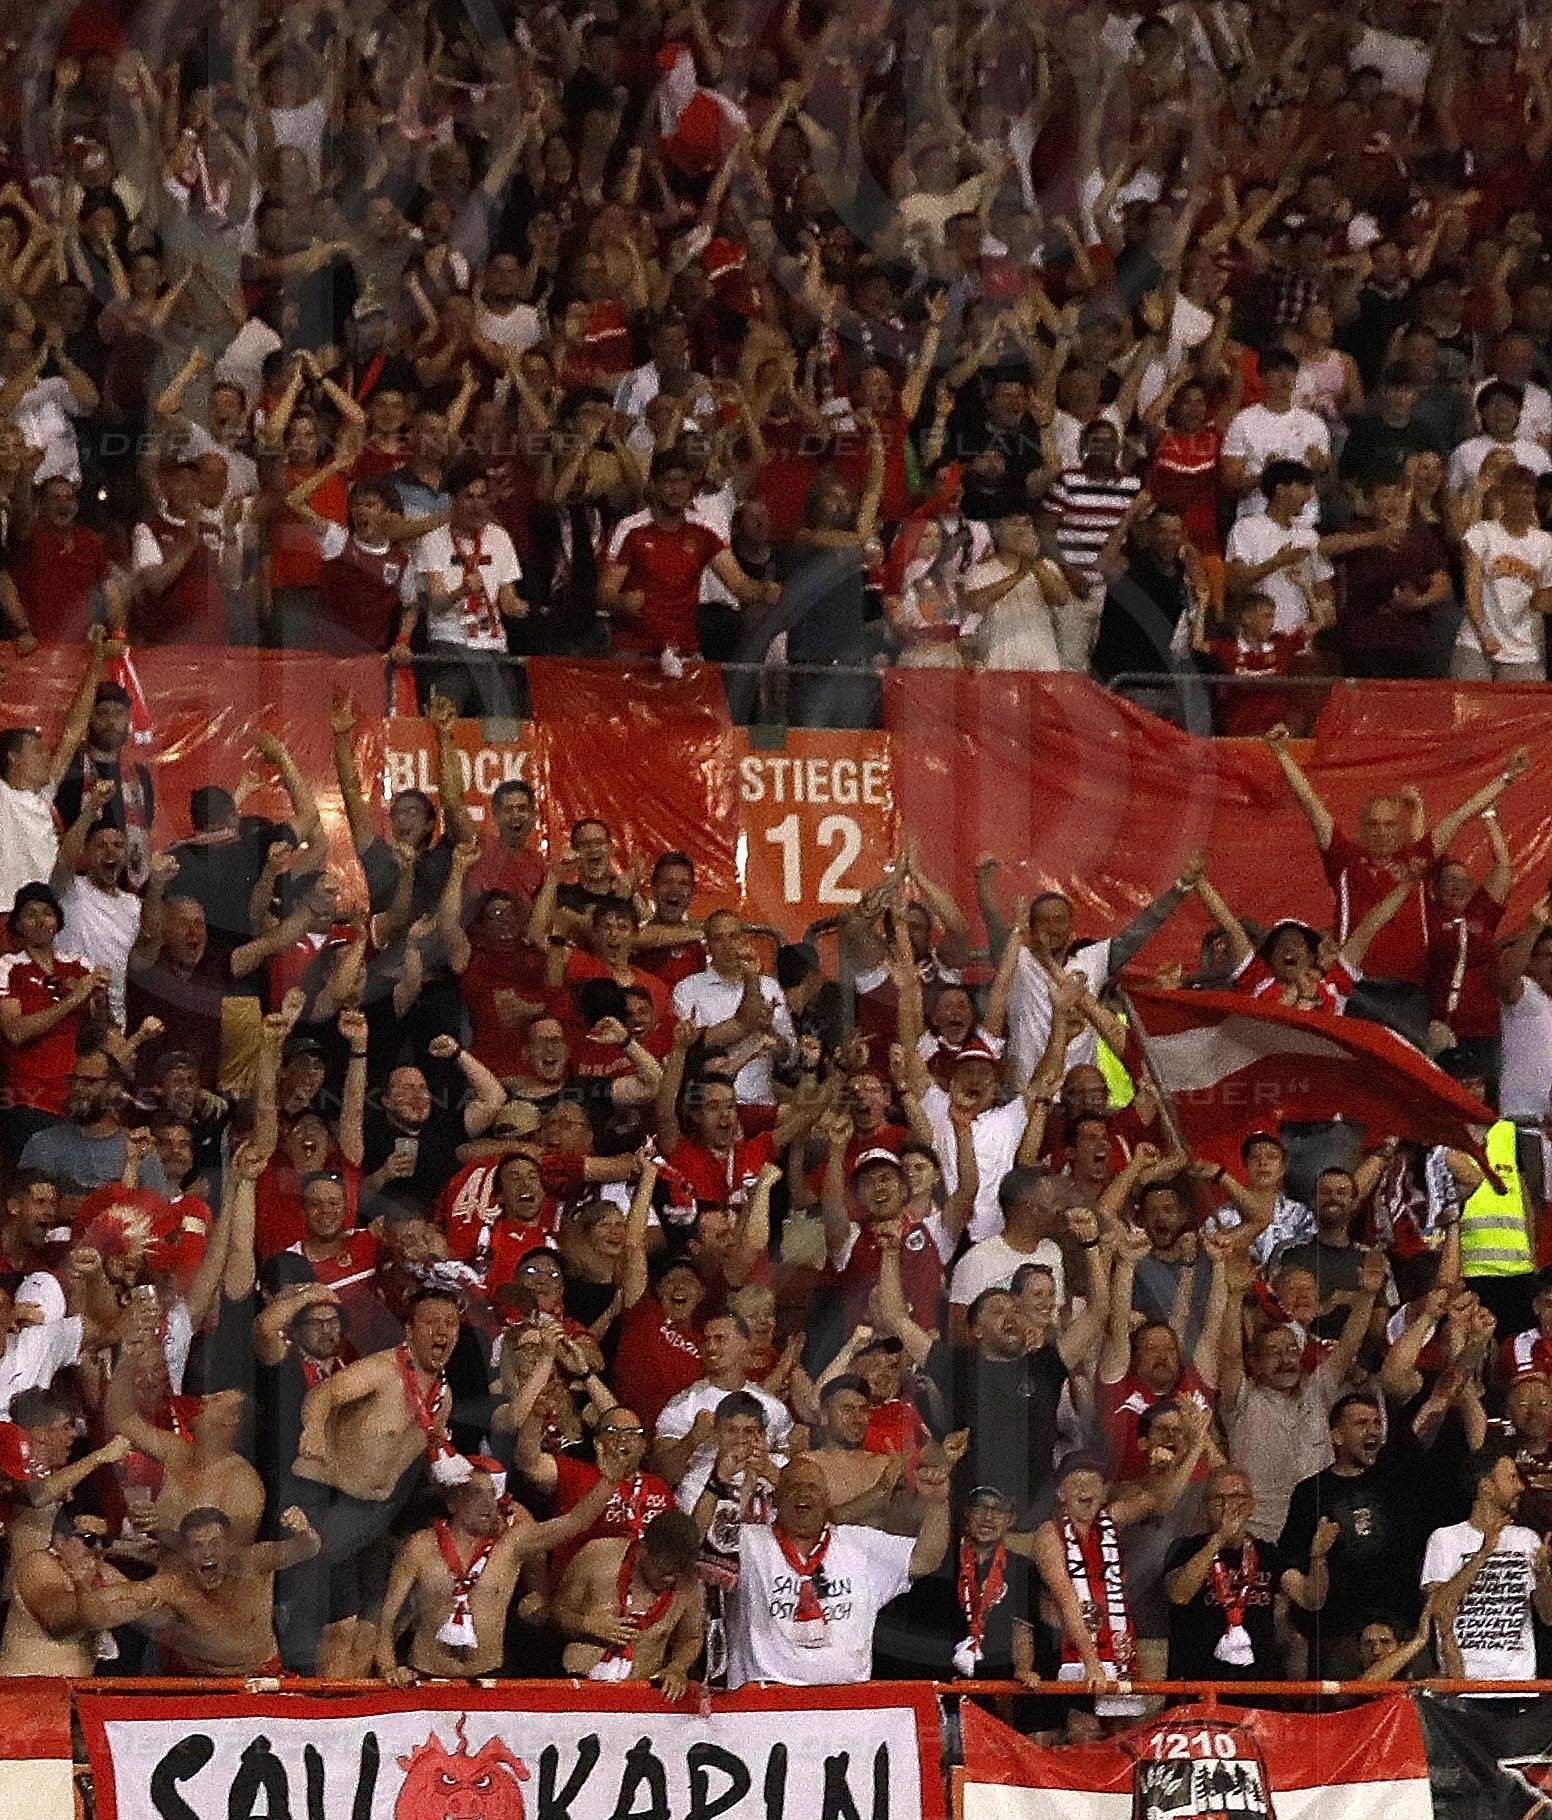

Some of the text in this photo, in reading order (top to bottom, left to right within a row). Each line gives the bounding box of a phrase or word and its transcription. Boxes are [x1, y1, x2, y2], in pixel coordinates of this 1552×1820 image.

[739, 755, 889, 804] STIEGE
[765, 813, 863, 904] 12
[1149, 1728, 1237, 1761] 1210
